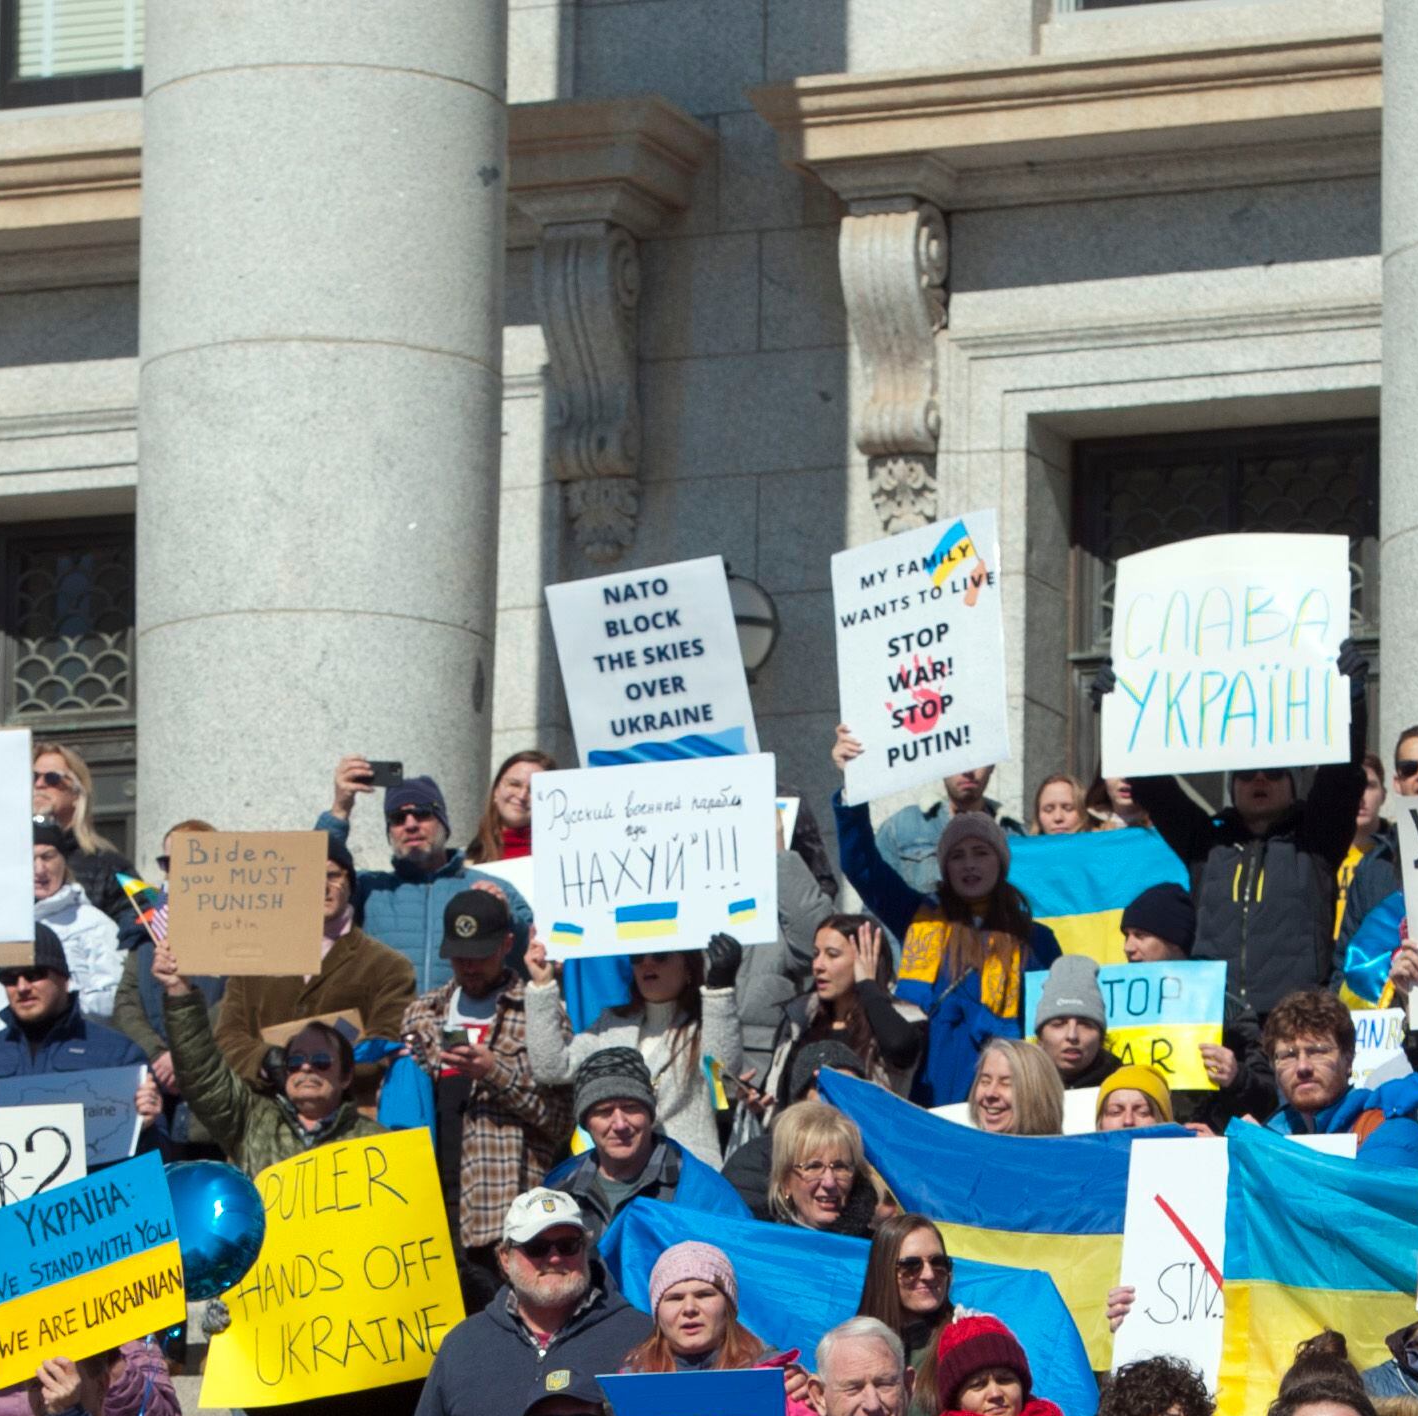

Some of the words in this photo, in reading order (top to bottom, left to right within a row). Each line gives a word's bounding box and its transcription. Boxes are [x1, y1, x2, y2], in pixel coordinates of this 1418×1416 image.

[860, 567, 888, 590] MY
[896, 543, 970, 578] FAMILY
[602, 577, 669, 605] NATO
[839, 594, 911, 629] WANTS
[918, 584, 944, 606] TO
[951, 570, 996, 595] LIVE
[604, 608, 682, 639] BLOCK
[887, 622, 950, 658] STOP
[1126, 584, 1332, 660] СЛАВА
[593, 653, 638, 674] THE
[643, 637, 706, 666] SKIES
[625, 674, 687, 701] OVER
[887, 656, 955, 694] WAR!
[609, 702, 715, 738] UKRAINE
[890, 693, 955, 729] STOP
[1117, 655, 1334, 754] УКРАЇНІ
[887, 724, 971, 768] PUTIN!
[185, 838, 286, 866] Biden,
[181, 873, 215, 894] you
[230, 866, 298, 887] MUST
[197, 893, 285, 912] PUNISH
[1101, 976, 1182, 1018] TOP
[1120, 1037, 1176, 1074] AR
[29, 1252, 93, 1288] STAND
[88, 1235, 132, 1267] WITH
[237, 1250, 345, 1322] HANDS
[363, 1237, 442, 1291] OFF
[38, 1307, 78, 1347] ARE
[82, 1264, 184, 1330] UKRAINIAN
[255, 1303, 448, 1387] UKRAINE
